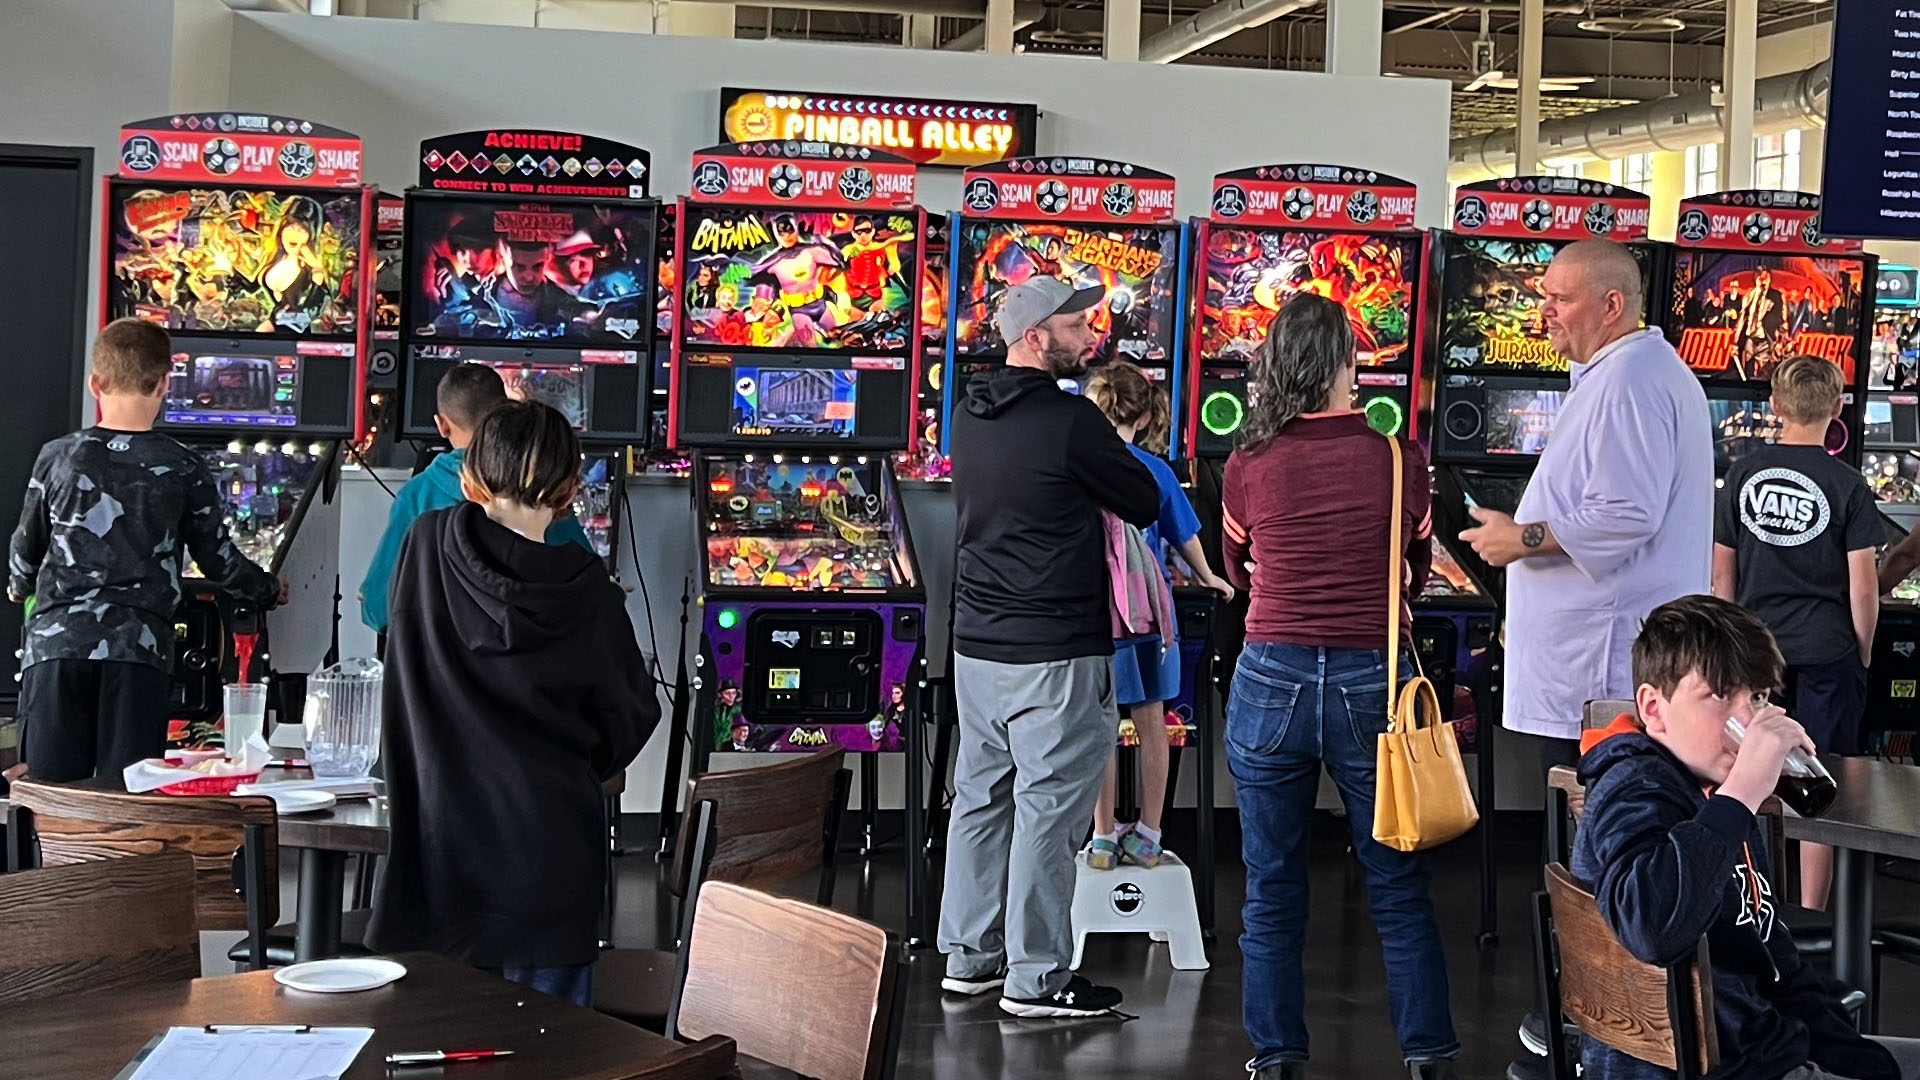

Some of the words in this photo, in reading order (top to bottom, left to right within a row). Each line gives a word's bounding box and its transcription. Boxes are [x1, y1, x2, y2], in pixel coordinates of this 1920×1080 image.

[1890, 69, 1909, 80] Dirty
[484, 132, 582, 152] ACHIEVE!
[784, 113, 915, 148] PINBALL
[921, 120, 1014, 152] ALLEY
[162, 141, 198, 163] SCAN
[242, 145, 275, 167] PLAY
[318, 149, 360, 171] SHARE
[432, 179, 489, 193] CONNECT
[490, 182, 507, 193] TO
[508, 183, 535, 194] WIN
[536, 184, 627, 197] ACHIEVEMENTS
[731, 166, 764, 187] SCAN
[805, 169, 836, 191] PLAY
[875, 173, 914, 194] SHARE
[1000, 183, 1032, 203] SCAN
[1071, 186, 1100, 206] PLAY
[1137, 189, 1174, 209] SHARE
[1248, 190, 1279, 210] SCAN
[1316, 194, 1344, 213] PLAY
[1380, 196, 1415, 216] SHARE
[1488, 201, 1519, 221] SCAN
[1554, 205, 1582, 224] PLAY
[1616, 208, 1649, 227] SHARE
[1710, 214, 1740, 234] SCAN
[1773, 218, 1800, 237] PLAY
[691, 213, 772, 254] BATMAN
[1063, 228, 1163, 267] GUARDIANS
[1081, 246, 1156, 278] GALAXY
[1485, 338, 1556, 365] JURASSIC
[1678, 328, 1731, 370] JOHN
[1797, 333, 1854, 371] WICK
[1747, 483, 1817, 523] VANS
[1755, 512, 1783, 528] Since
[1781, 517, 1808, 532] 1966
